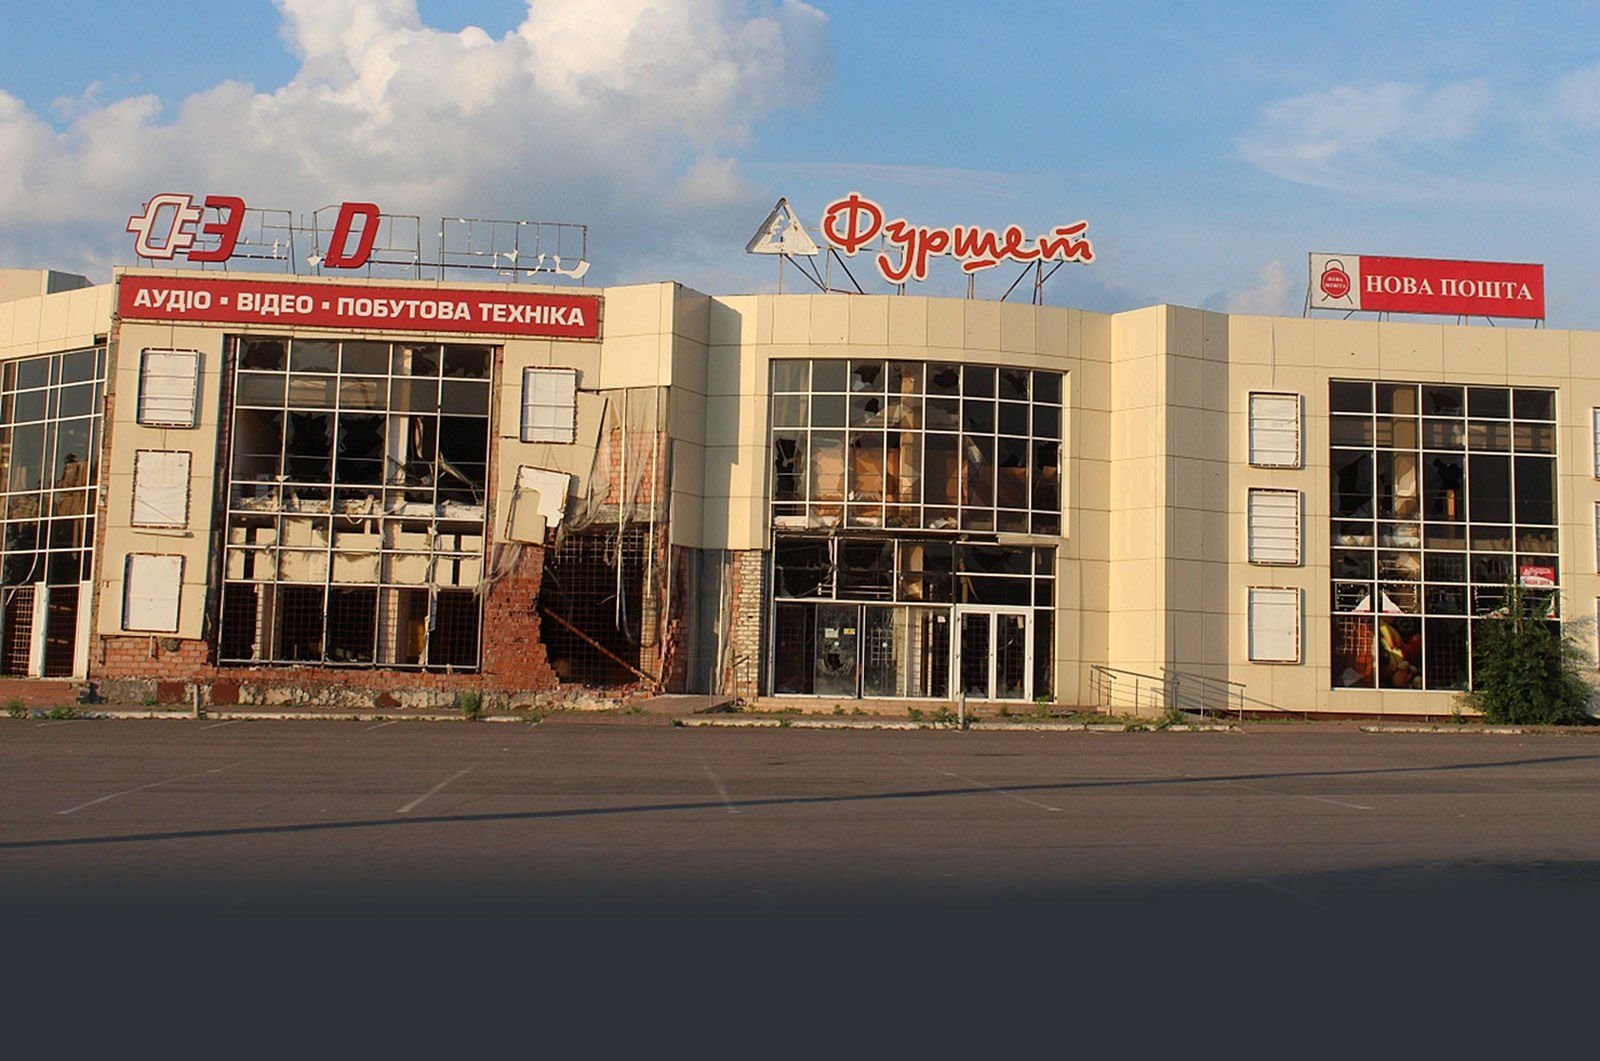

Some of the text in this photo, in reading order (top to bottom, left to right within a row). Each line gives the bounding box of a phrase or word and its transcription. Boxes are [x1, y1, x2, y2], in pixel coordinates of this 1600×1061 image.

[822, 193, 1094, 282] Фуршет
[1366, 275, 1533, 300] НОВА ПОШТА
[133, 288, 585, 326] АУДІО ВІДЕО ПОБУТОВА ТЕХНІКА
